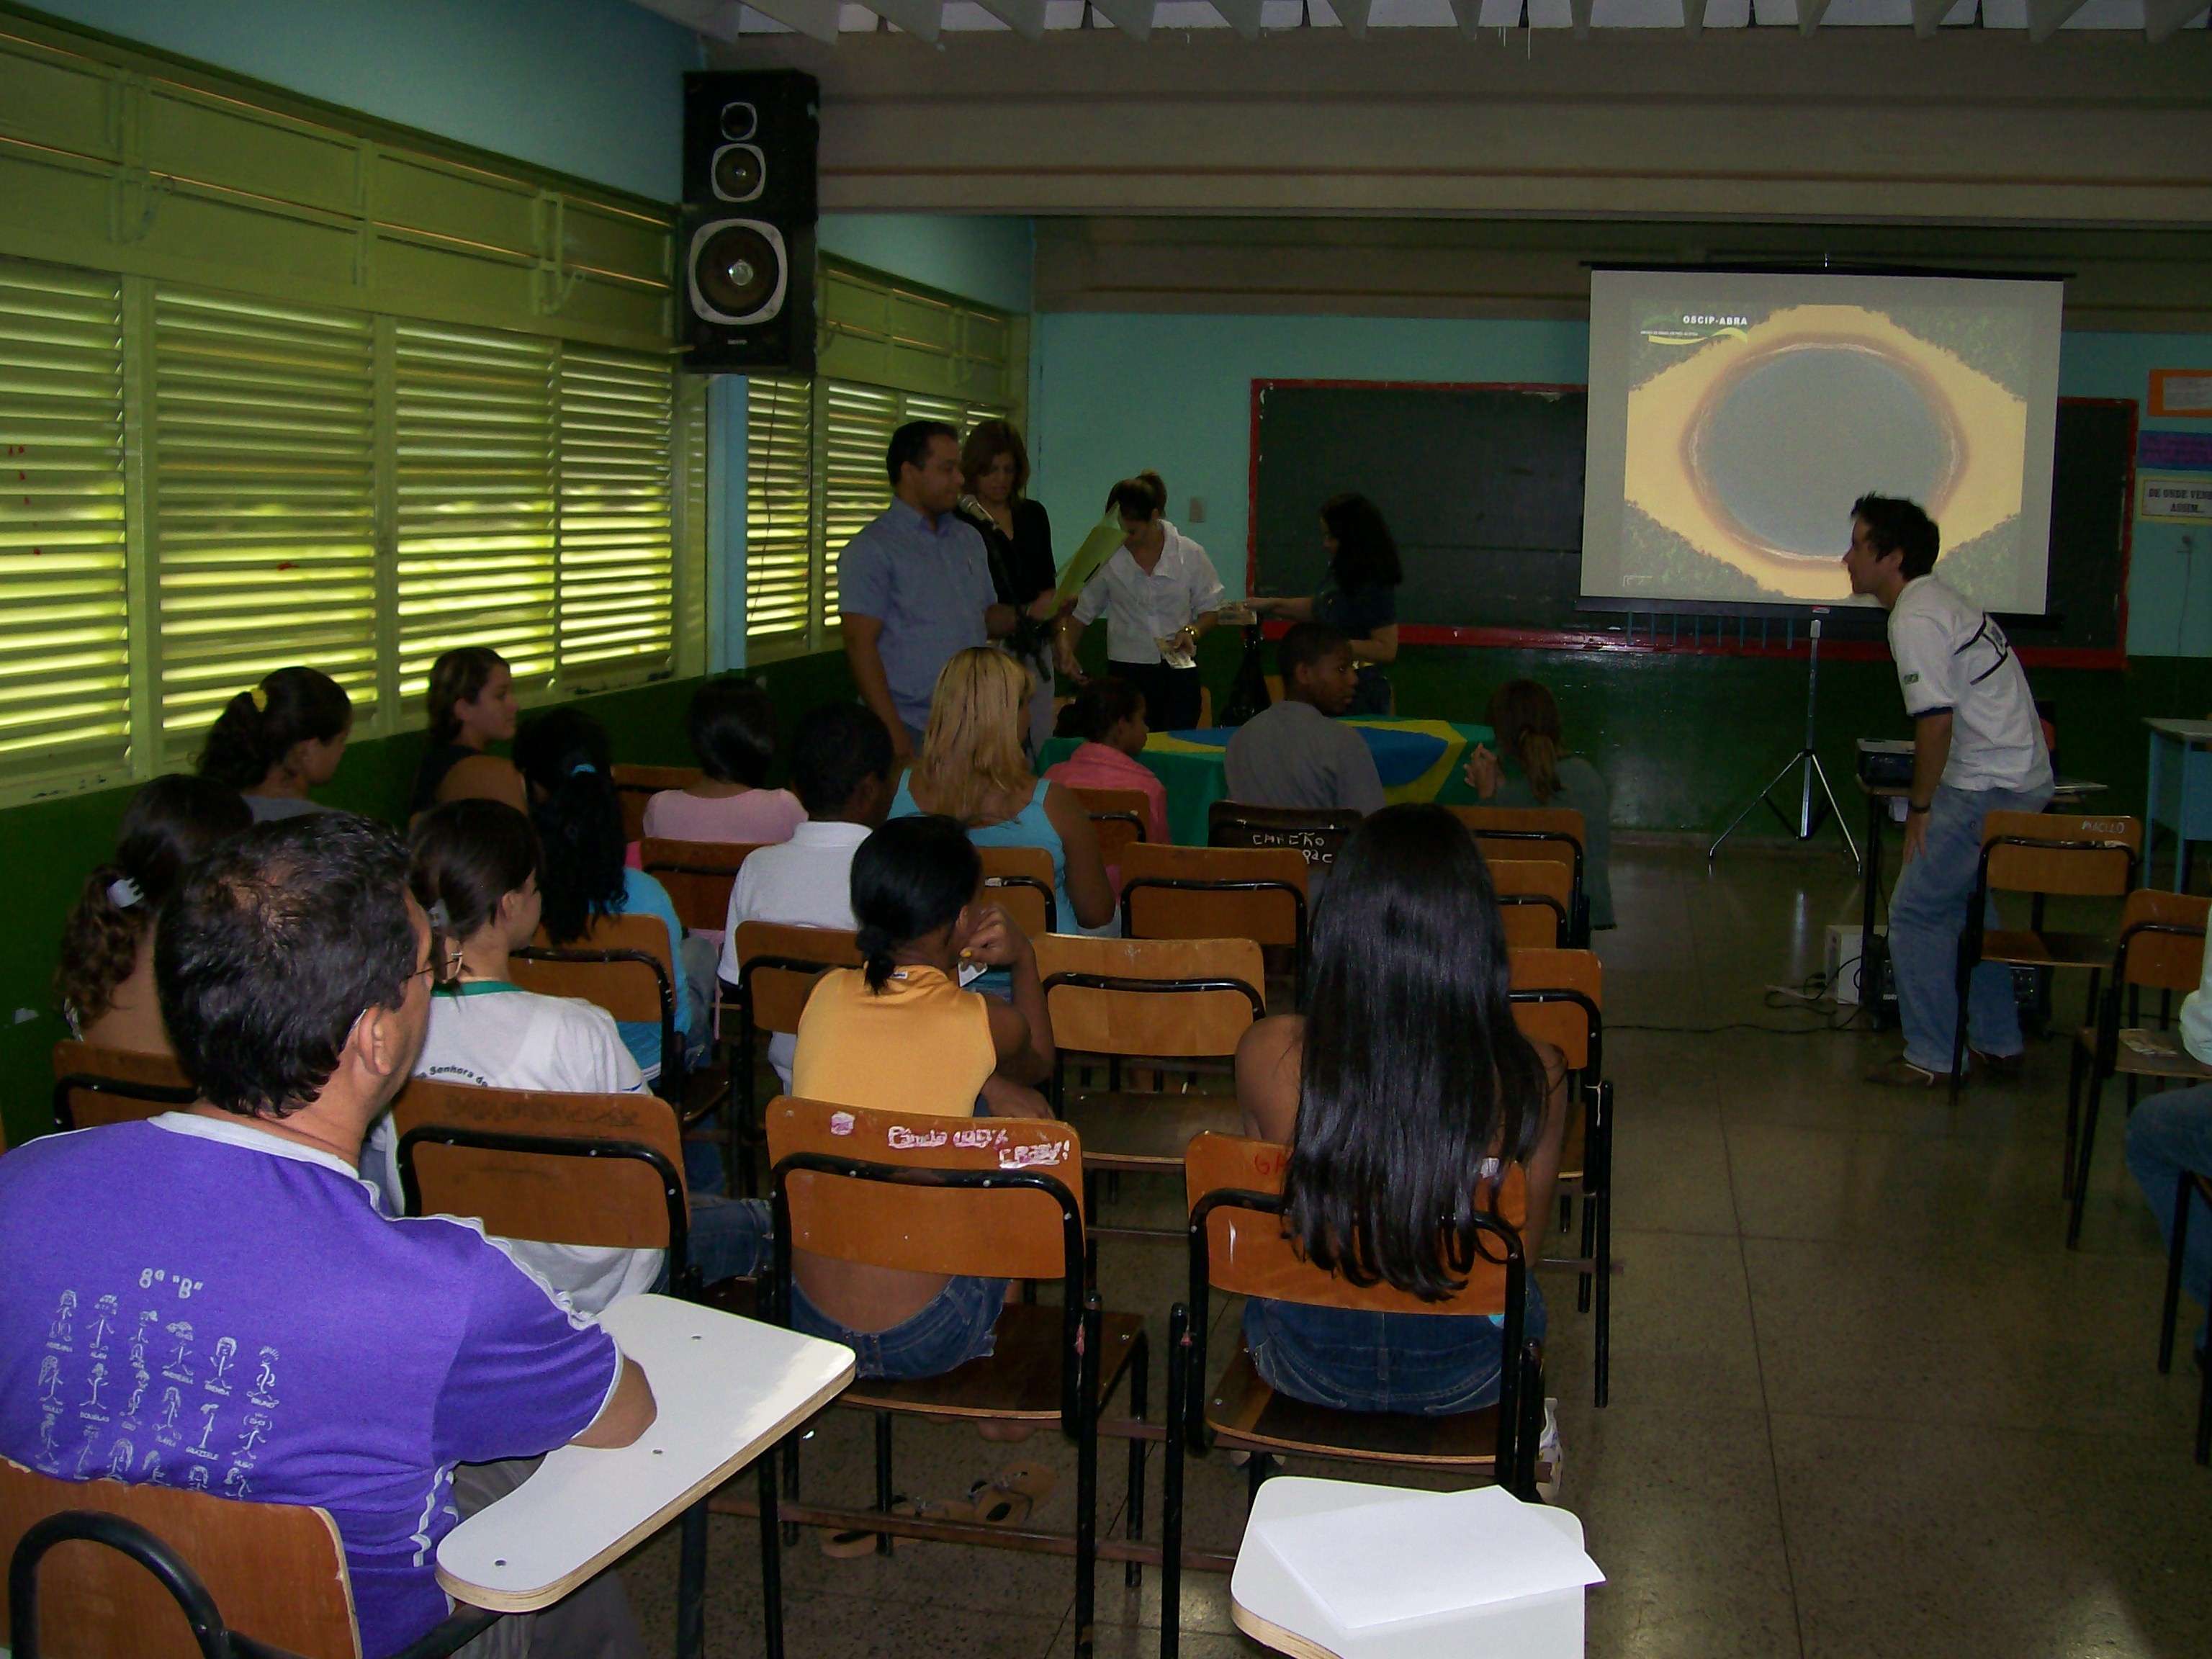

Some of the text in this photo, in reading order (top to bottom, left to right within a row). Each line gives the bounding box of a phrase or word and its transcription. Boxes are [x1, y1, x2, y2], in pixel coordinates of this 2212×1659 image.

[1683, 315, 1748, 325] OSCIP-ABRA
[2149, 488, 2160, 498] DE
[2163, 489, 2188, 498] ONDE
[429, 1065, 474, 1079] Senhora
